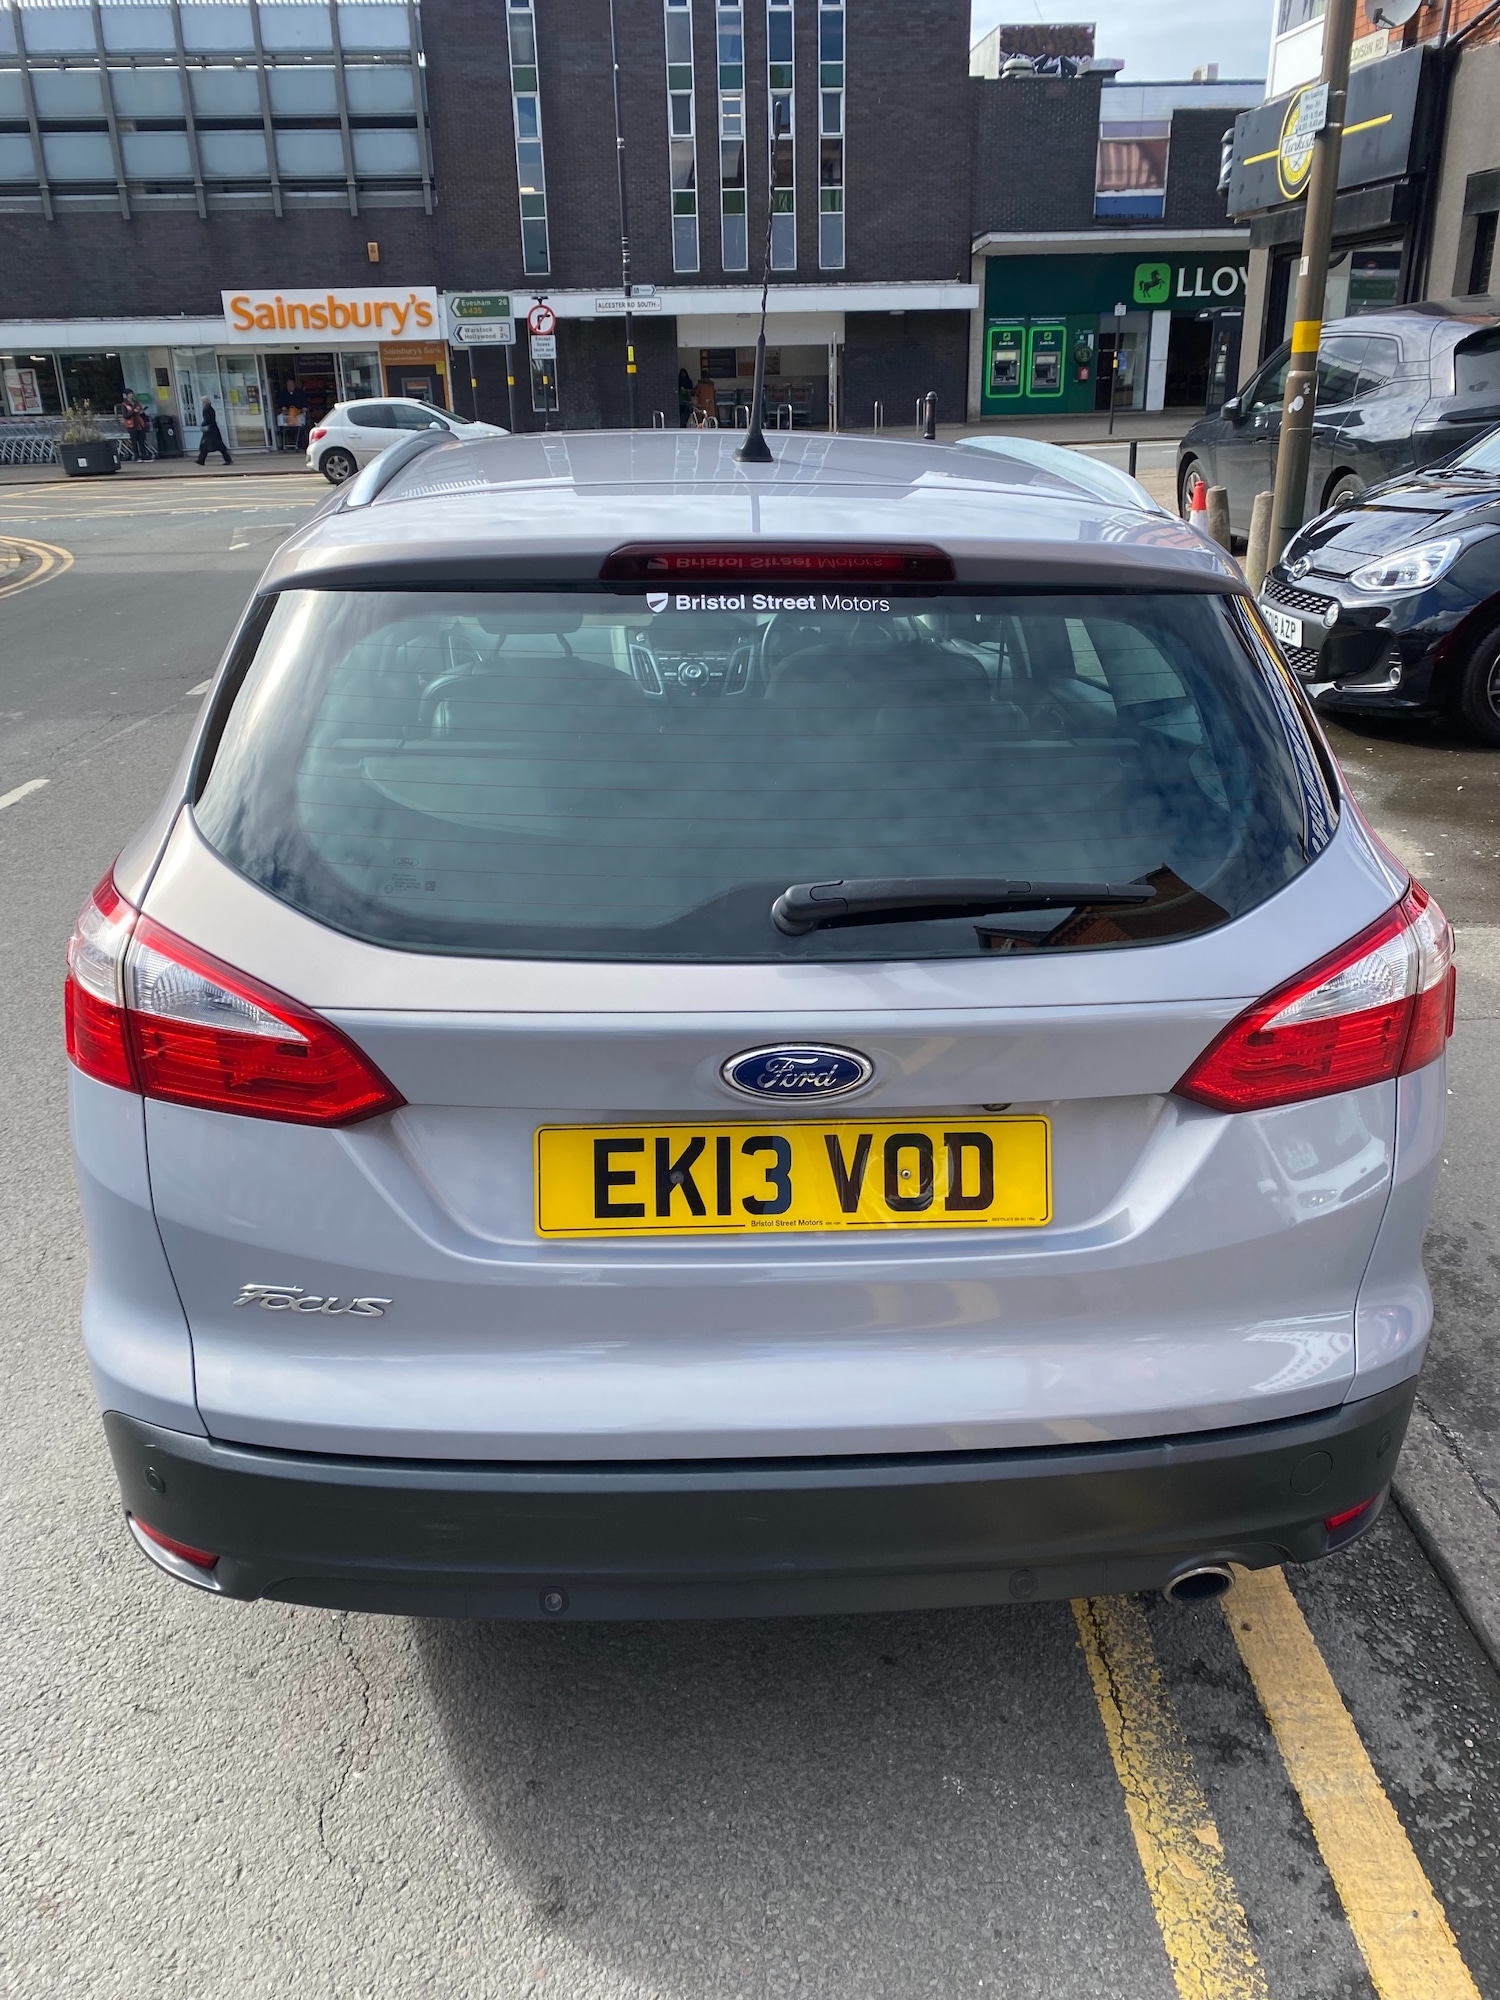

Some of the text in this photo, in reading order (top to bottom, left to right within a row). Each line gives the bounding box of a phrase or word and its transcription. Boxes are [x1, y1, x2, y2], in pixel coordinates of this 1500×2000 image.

[1375, 37, 1385, 52] RD
[461, 298, 507, 307] Evesham 26
[597, 301, 626, 309] ALCESTER
[230, 293, 433, 336] Sainsbury's
[383, 346, 442, 356] Sainsbury's Bank
[675, 593, 890, 612] Bristol Street Motors
[1280, 617, 1296, 640] AZP
[757, 1057, 838, 1088] Ford
[593, 1132, 994, 1219] EK13 VOD
[775, 1219, 797, 1227] Street
